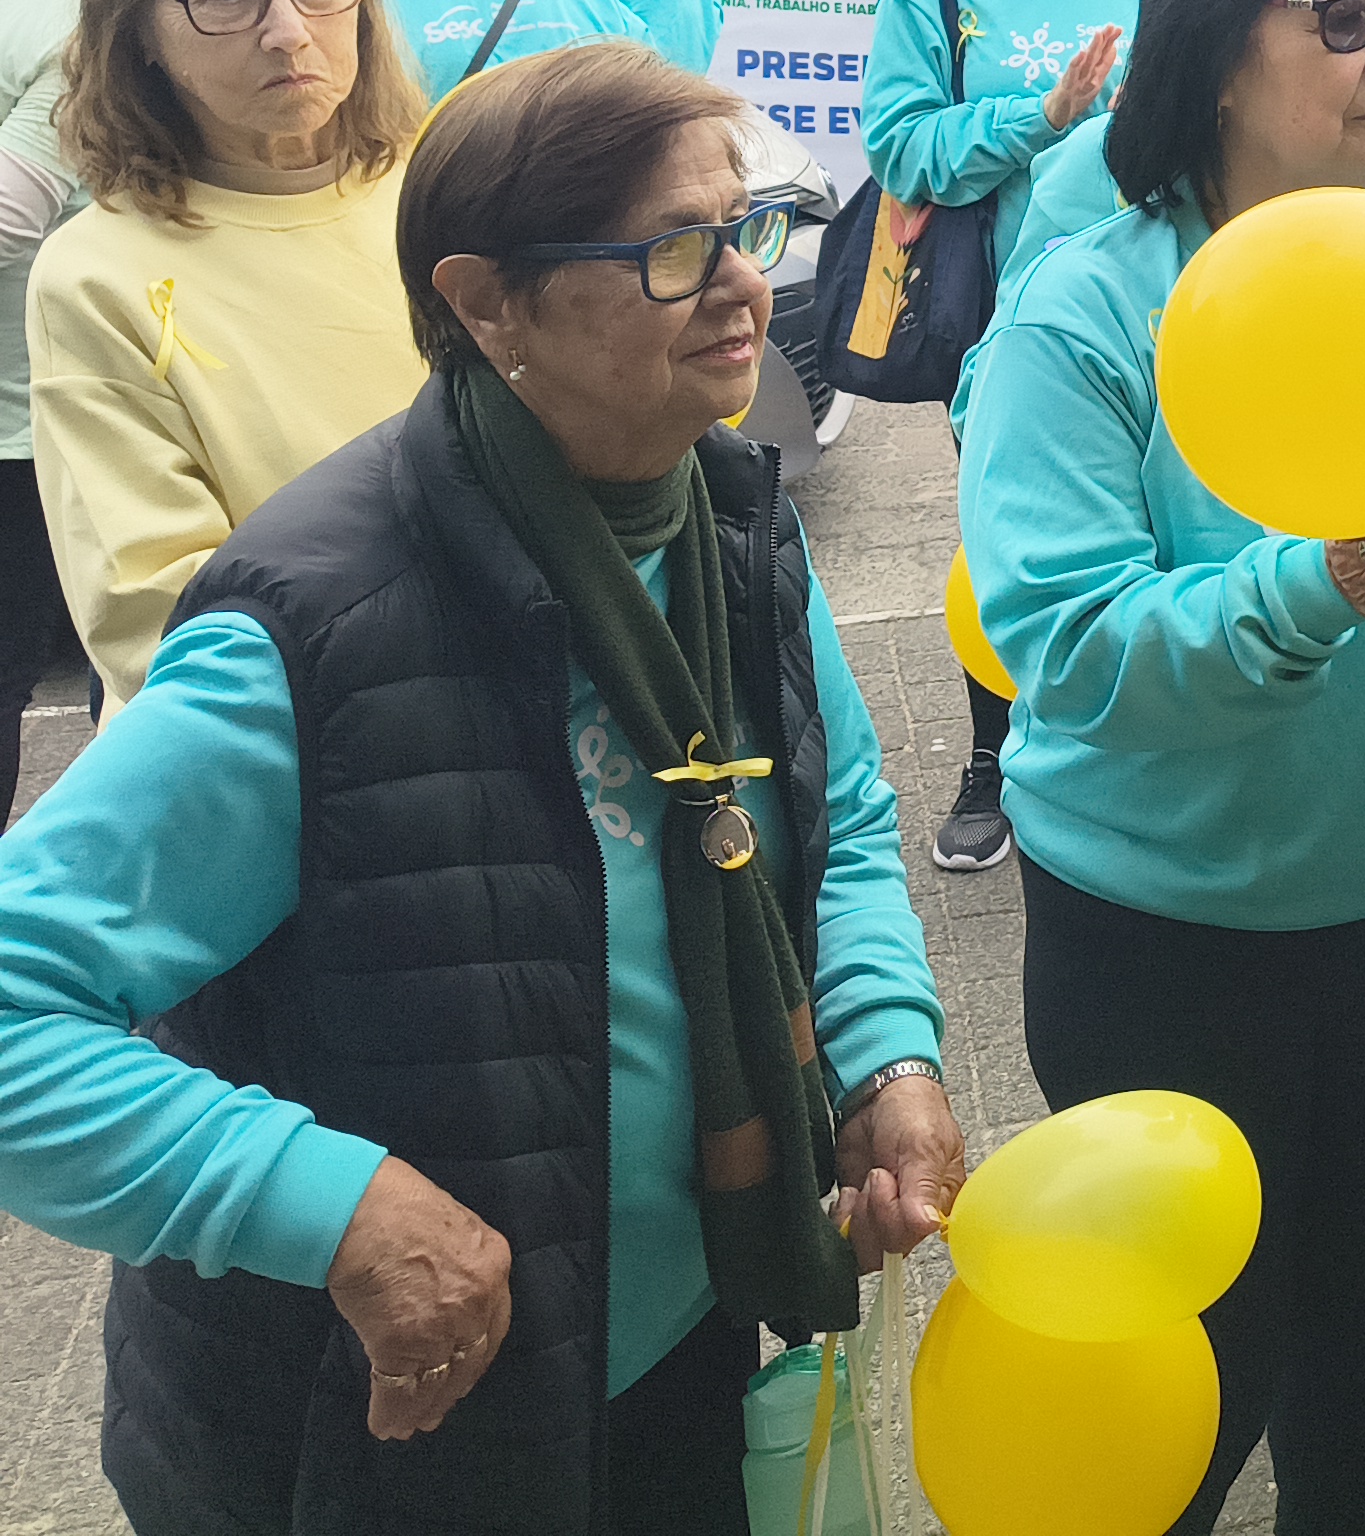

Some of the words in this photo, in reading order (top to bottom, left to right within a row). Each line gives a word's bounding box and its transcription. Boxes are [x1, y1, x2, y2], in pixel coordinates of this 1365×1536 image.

[834, 2, 843, 14] E
[846, 2, 878, 15] HAB
[736, 49, 870, 83] PRESE
[755, 104, 816, 134] SE
